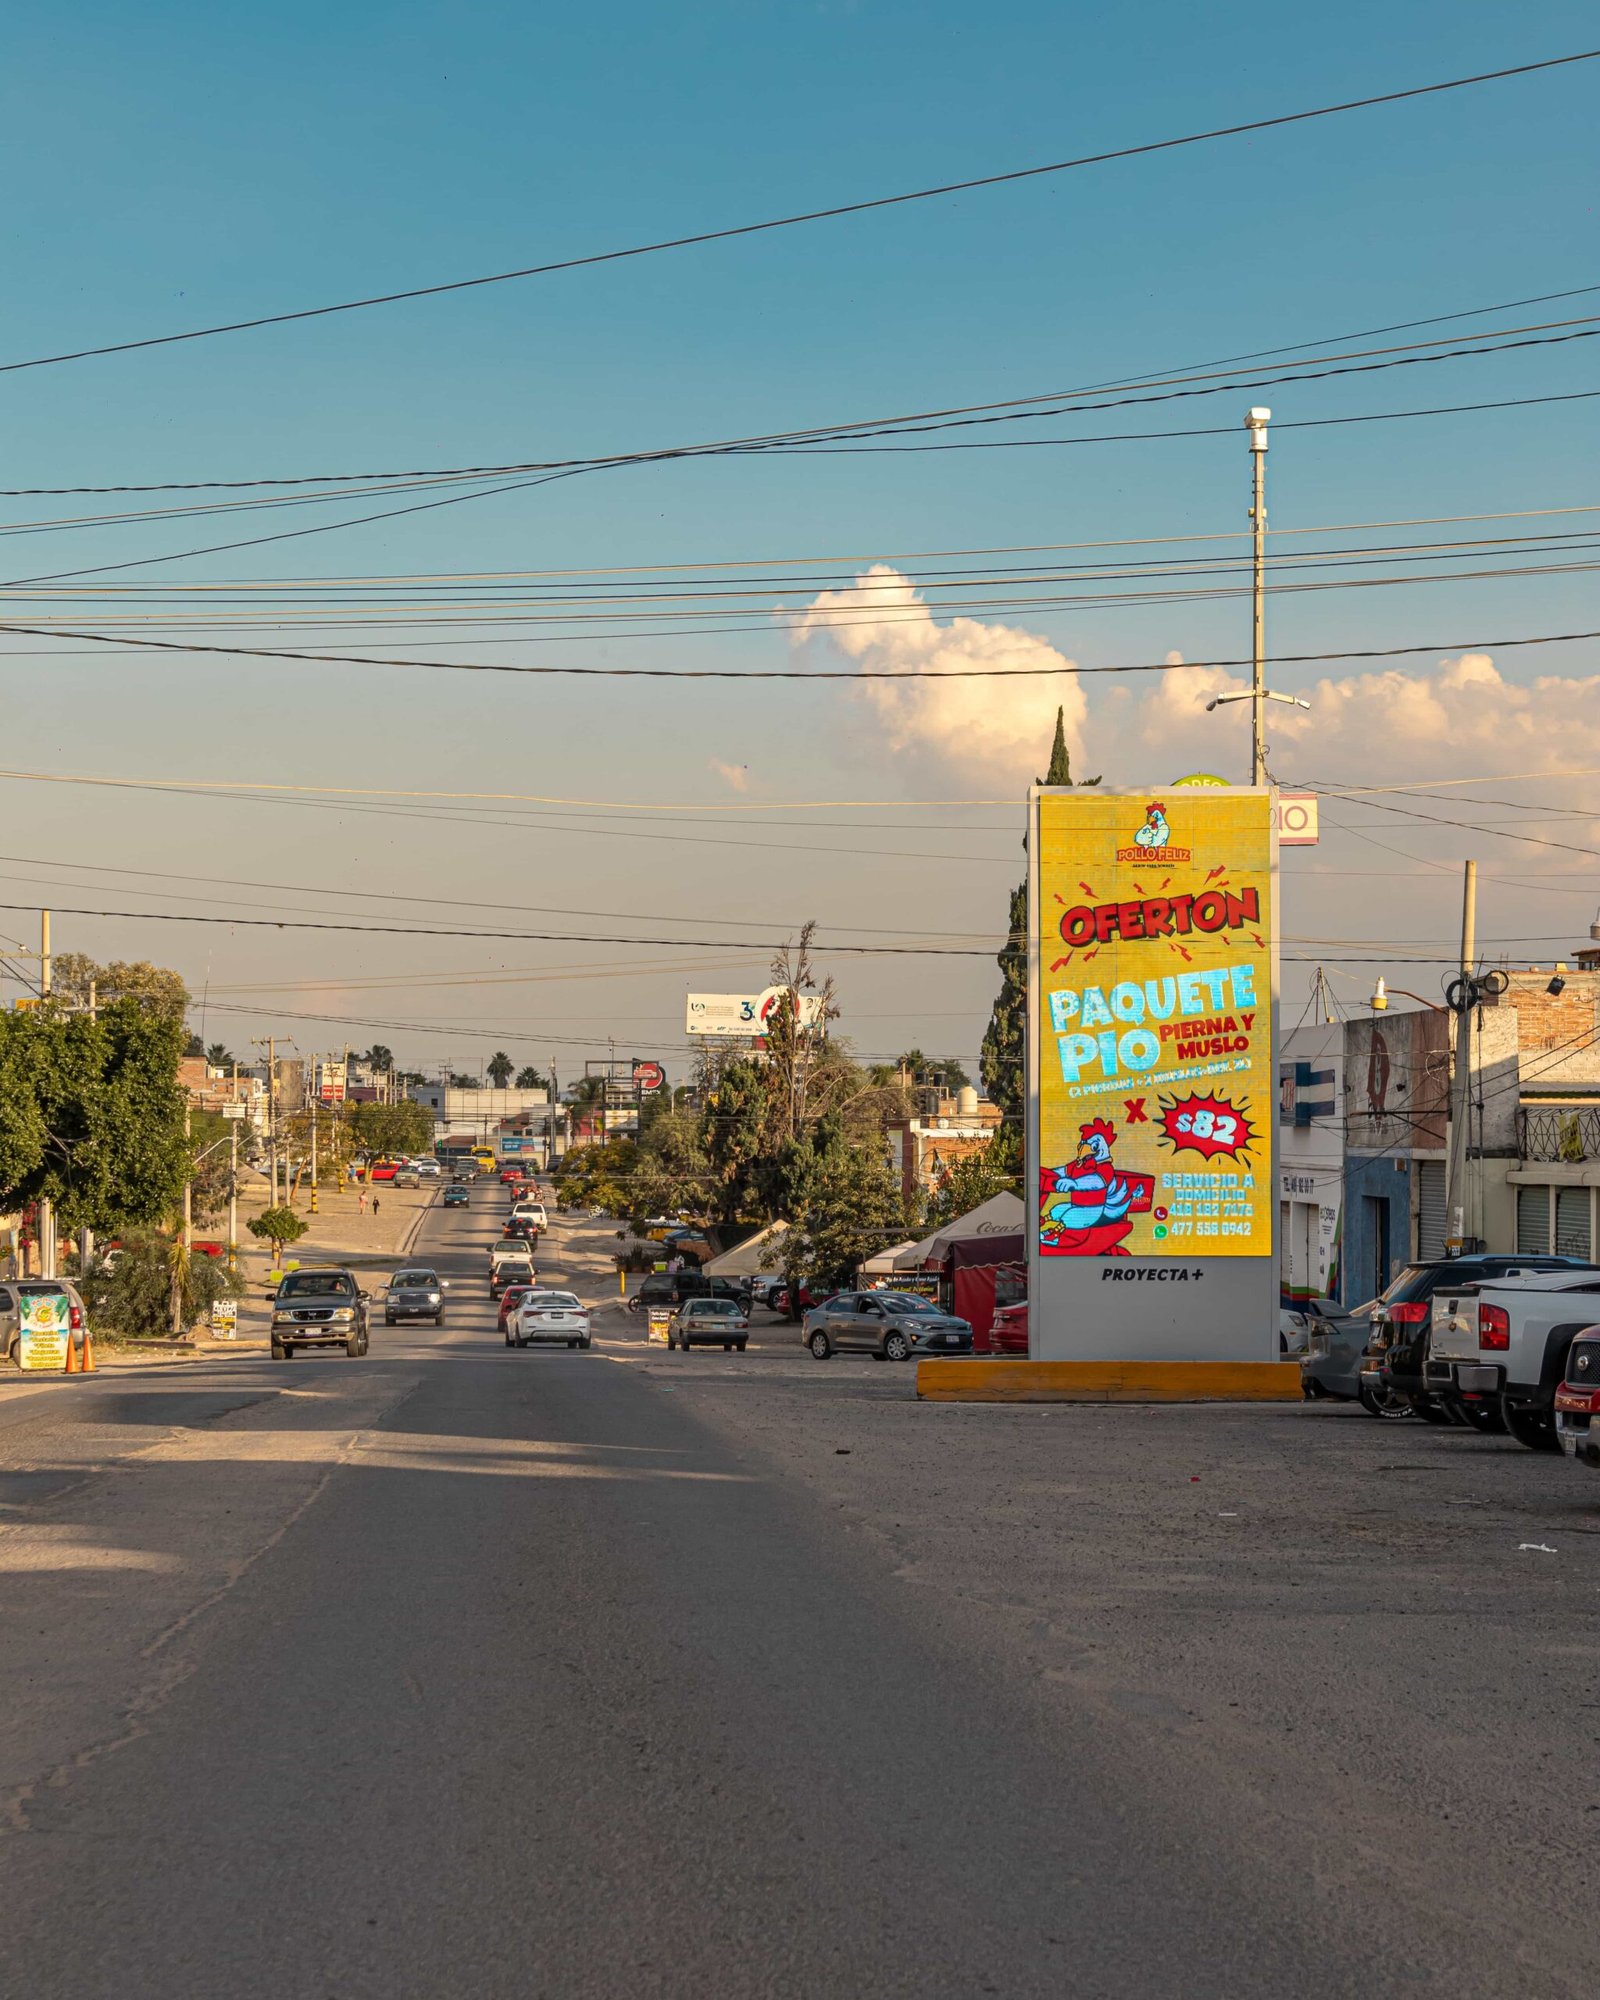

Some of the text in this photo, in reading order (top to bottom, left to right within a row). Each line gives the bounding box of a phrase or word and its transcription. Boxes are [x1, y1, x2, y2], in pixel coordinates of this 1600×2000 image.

[1117, 847, 1190, 862] POLLO FELIZ
[1060, 888, 1260, 947] OFERTON
[1048, 964, 1257, 1033] PAQUETE
[1159, 1013, 1256, 1042] PIERNA Y
[1057, 1028, 1160, 1083] PIO
[1177, 1035, 1249, 1060] MUSLO
[1124, 1098, 1148, 1124] X
[1175, 1110, 1237, 1145] $82
[1162, 1173, 1254, 1188] SERVICIO A
[1175, 1189, 1246, 1200] DOMICILIO
[1171, 1221, 1193, 1236] 477
[1221, 1221, 1251, 1236] 0942
